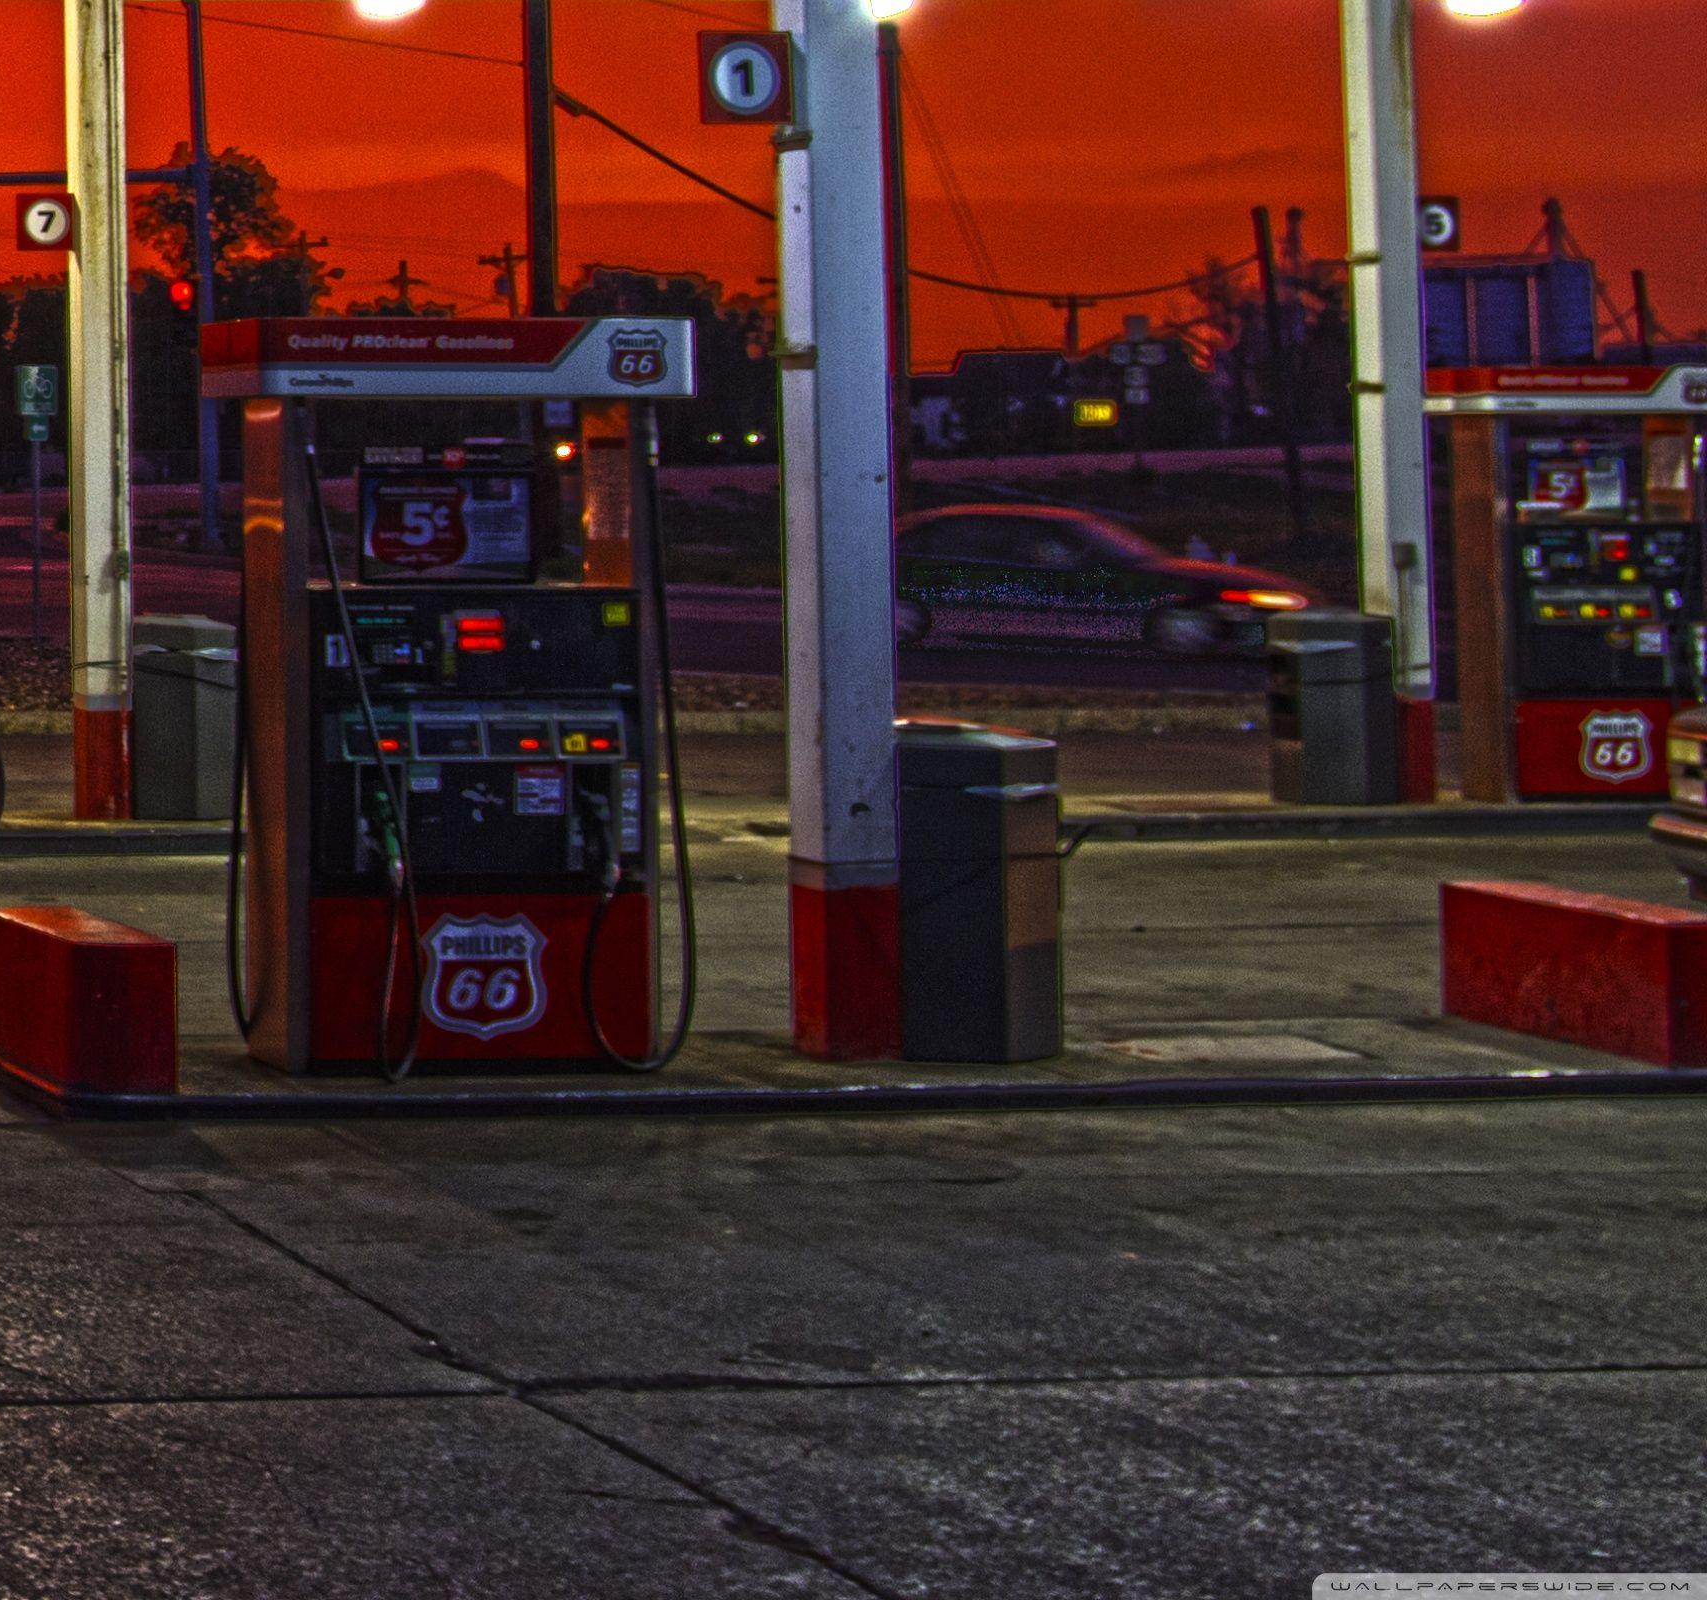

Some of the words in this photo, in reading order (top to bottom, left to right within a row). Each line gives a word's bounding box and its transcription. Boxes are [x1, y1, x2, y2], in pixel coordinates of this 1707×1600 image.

[732, 60, 754, 96] 1
[37, 210, 55, 233] 7
[1426, 213, 1445, 236] 5
[287, 334, 348, 351] Quality
[621, 354, 655, 374] 66
[1595, 741, 1634, 766] 66
[441, 934, 526, 956] PHILLIPS
[448, 966, 522, 1011] 66
